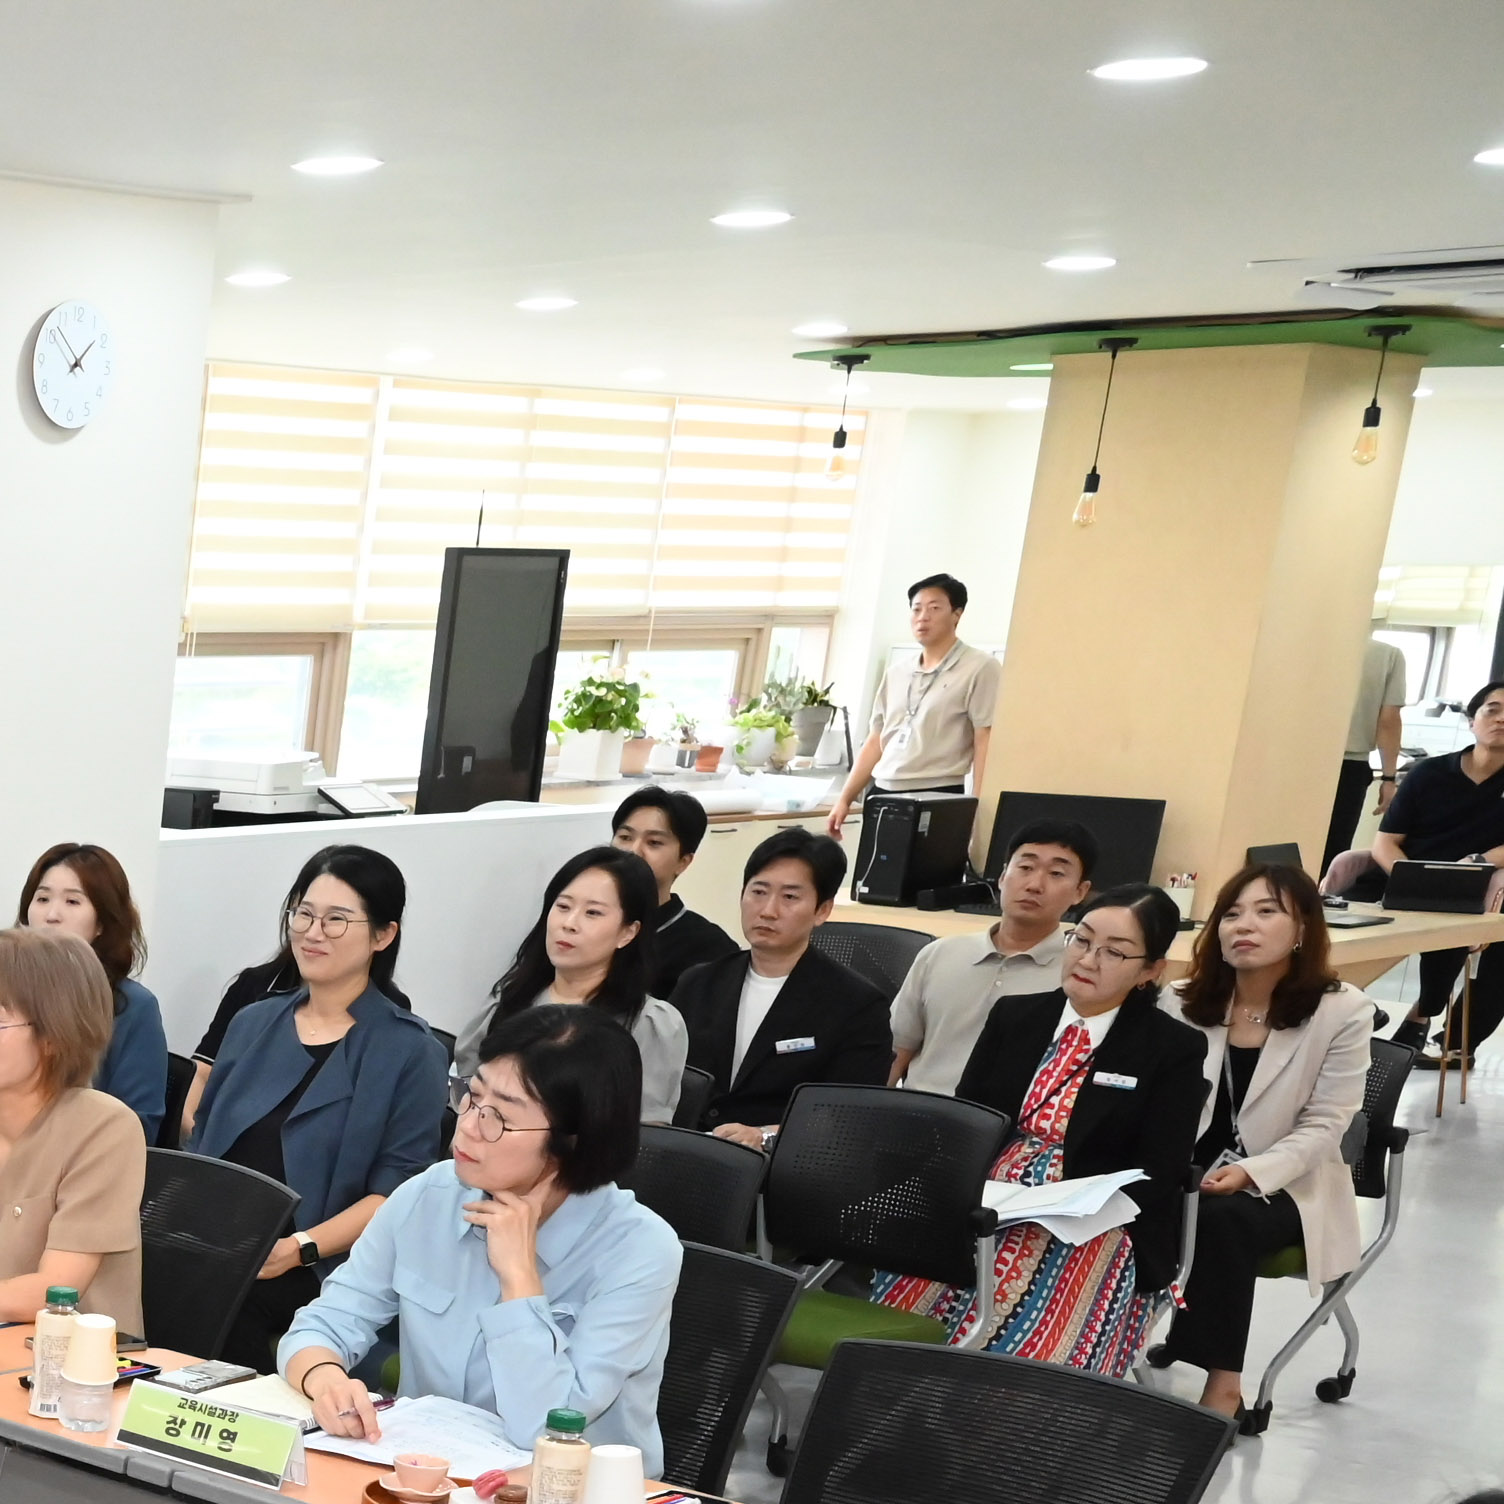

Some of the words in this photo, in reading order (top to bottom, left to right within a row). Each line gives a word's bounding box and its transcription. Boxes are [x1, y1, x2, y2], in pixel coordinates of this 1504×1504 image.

[73, 305, 85, 322] 12
[99, 332, 108, 349] 2
[37, 352, 46, 369] 9
[103, 360, 111, 376] 3
[40, 378, 48, 395] 8
[52, 398, 60, 415] 7
[66, 406, 74, 422] 6
[83, 401, 91, 418] 5
[176, 1396, 240, 1424] 교육시설과장
